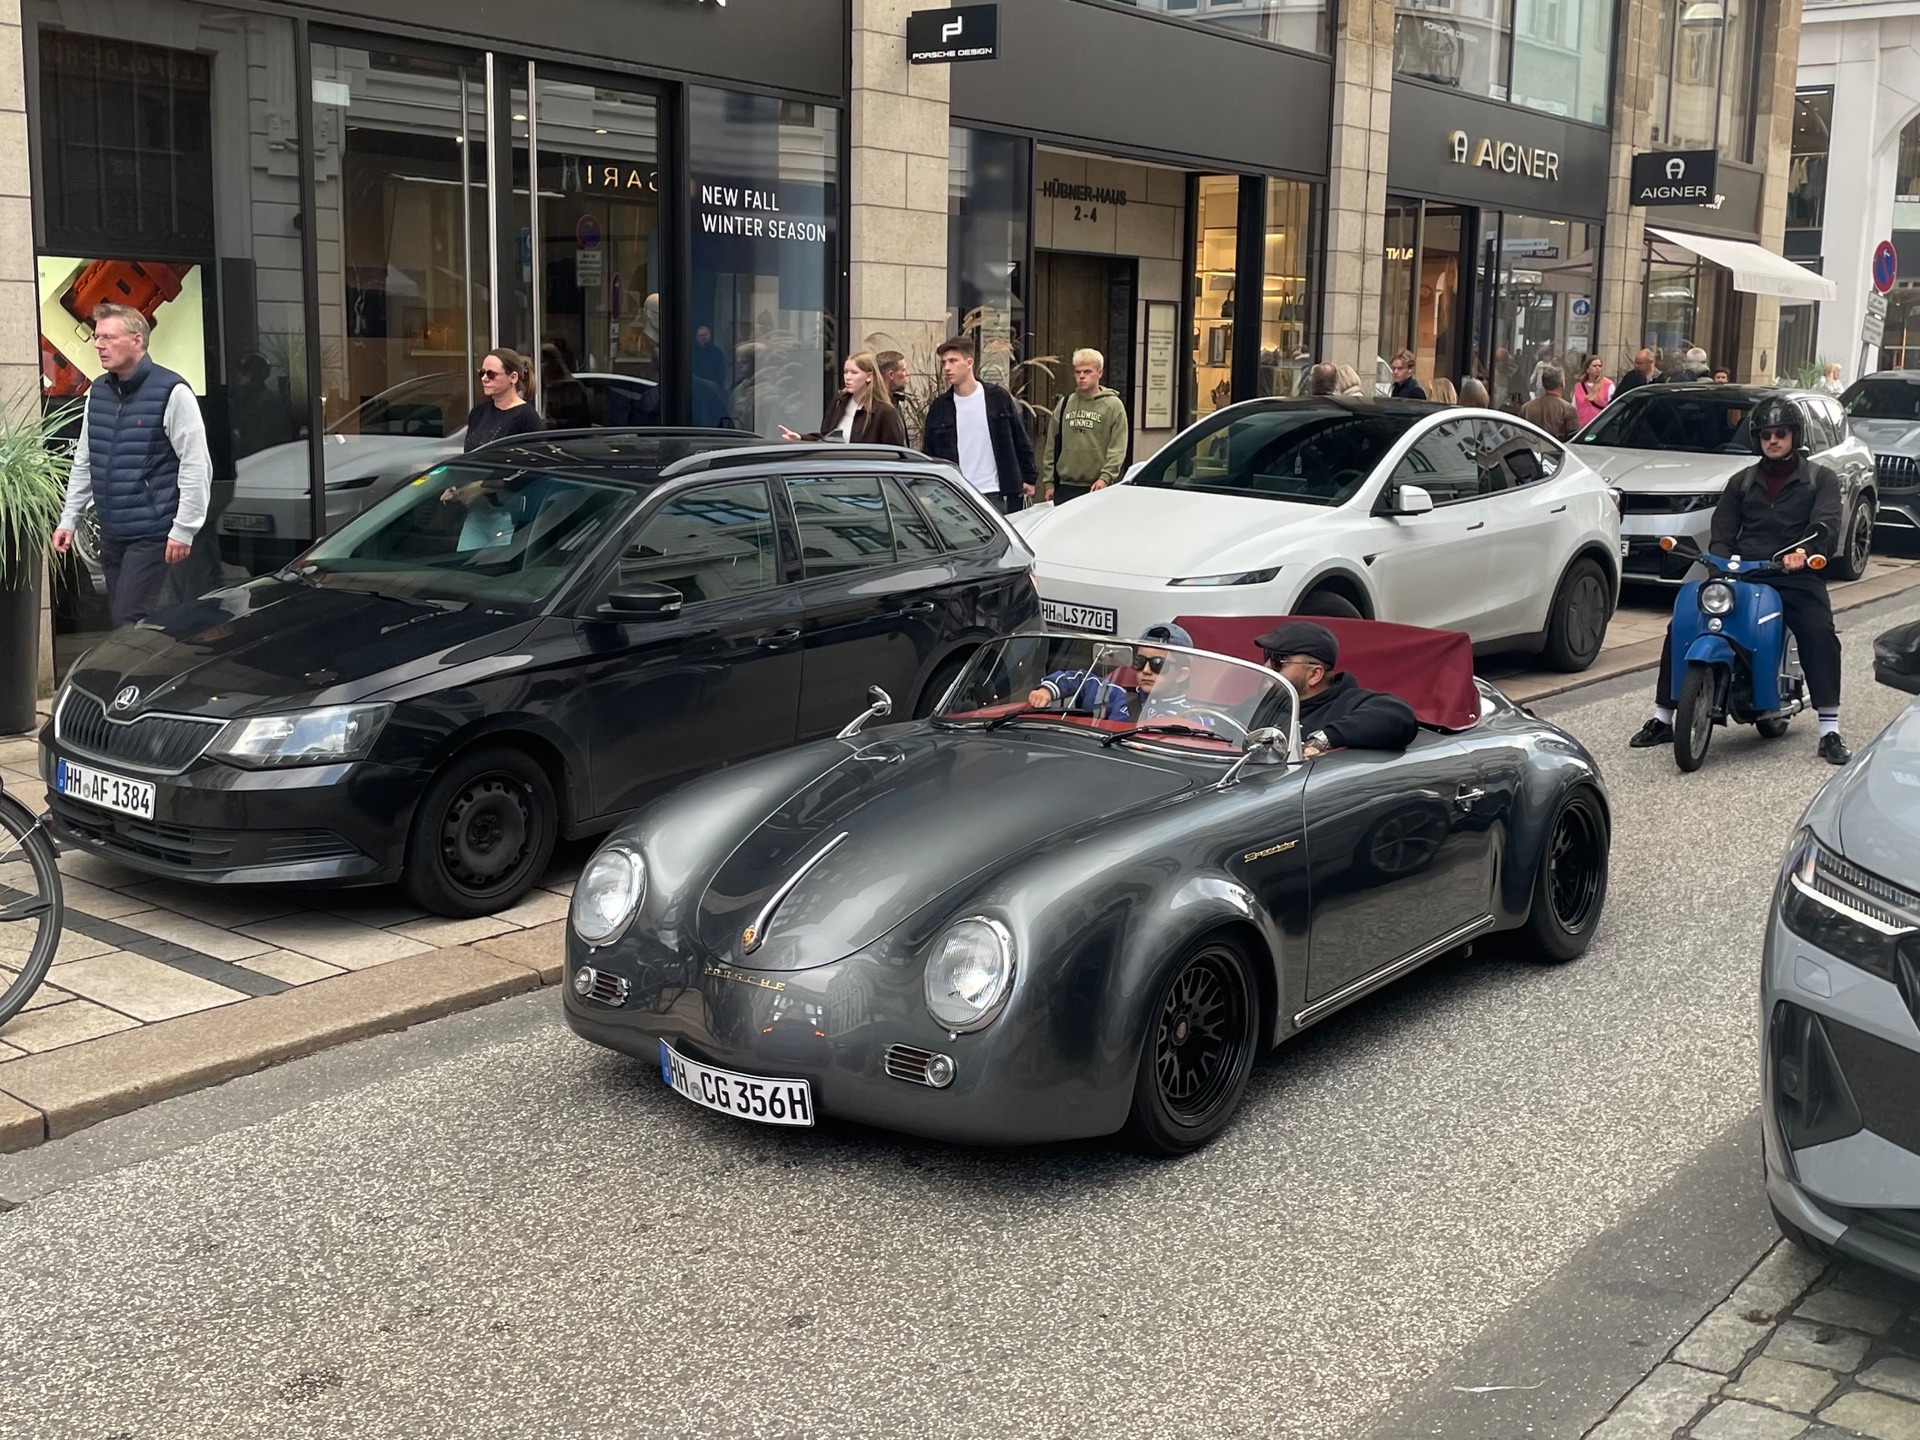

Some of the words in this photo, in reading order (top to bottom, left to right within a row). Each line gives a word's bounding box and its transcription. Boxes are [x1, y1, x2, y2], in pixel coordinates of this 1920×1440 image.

[912, 50, 956, 60] PORSCHE
[957, 47, 993, 57] DESIGN
[1475, 138, 1559, 181] AIGNER
[702, 185, 739, 207] NEW
[744, 190, 780, 211] FALL
[1043, 178, 1127, 206] HÜBNER-HAUS
[1640, 185, 1708, 199] AIGNER
[702, 212, 763, 237] WINTER
[768, 219, 827, 242] SEASON
[1065, 410, 1102, 423] WORLDWIDE
[1069, 419, 1094, 429] WINNER
[1041, 603, 1056, 620] HH
[66, 765, 82, 795] HH
[91, 774, 110, 803] AF
[111, 780, 150, 815] 1384
[668, 1053, 690, 1095] HH
[700, 1071, 732, 1110] CG
[733, 1080, 809, 1121] 356H
